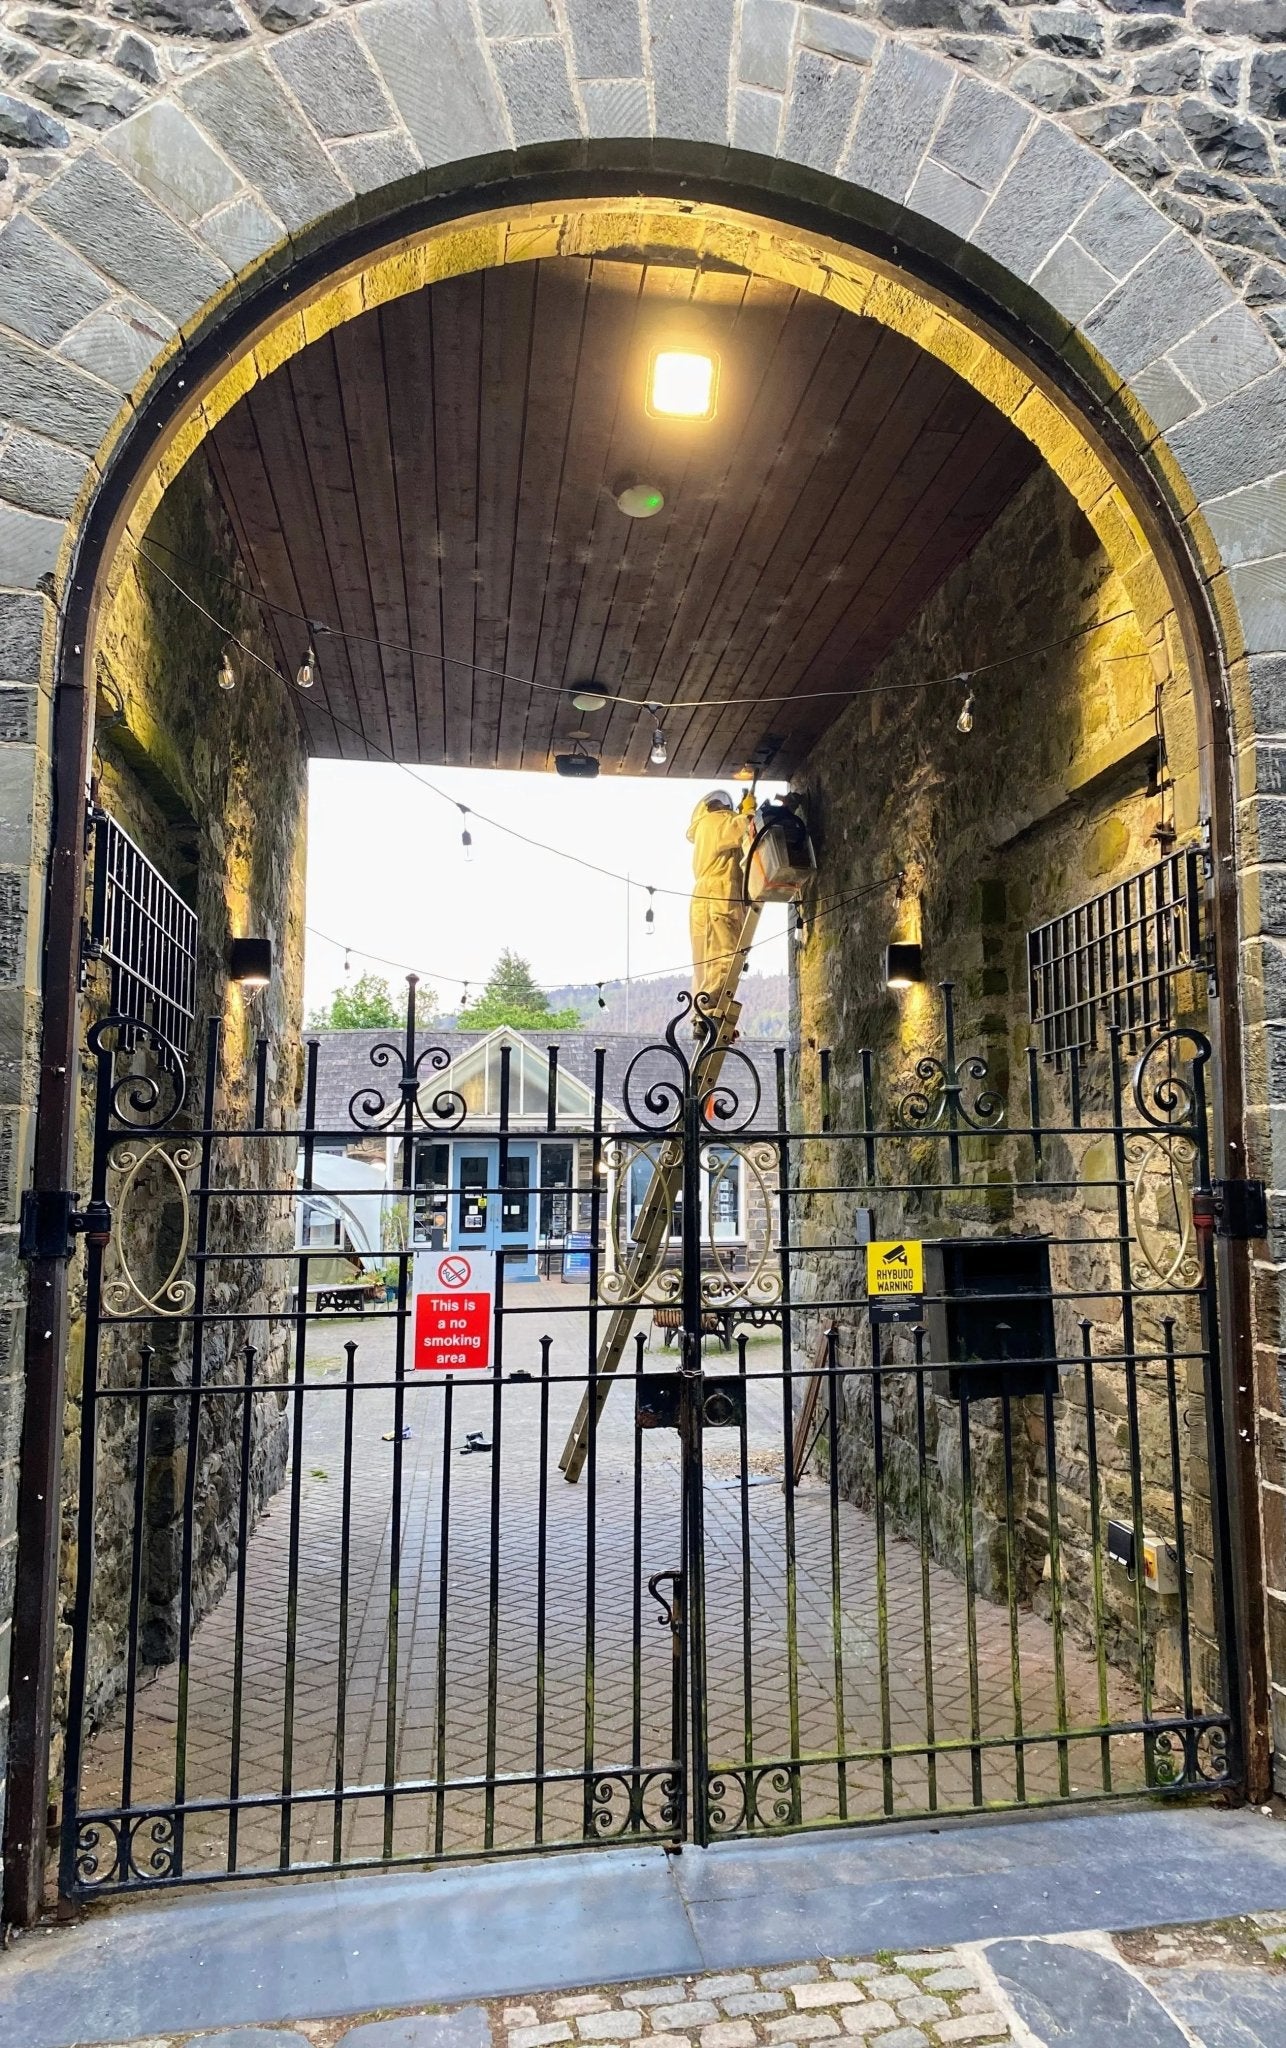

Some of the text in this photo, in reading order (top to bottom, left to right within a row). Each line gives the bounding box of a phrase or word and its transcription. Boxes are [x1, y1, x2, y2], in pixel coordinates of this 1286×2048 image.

[876, 1269, 913, 1280] RHYBUDD
[878, 1281, 913, 1292] WARNING
[431, 1300, 476, 1311] This is
[438, 1320, 467, 1329] a no
[424, 1335, 480, 1348] smoking
[437, 1354, 466, 1363] area
